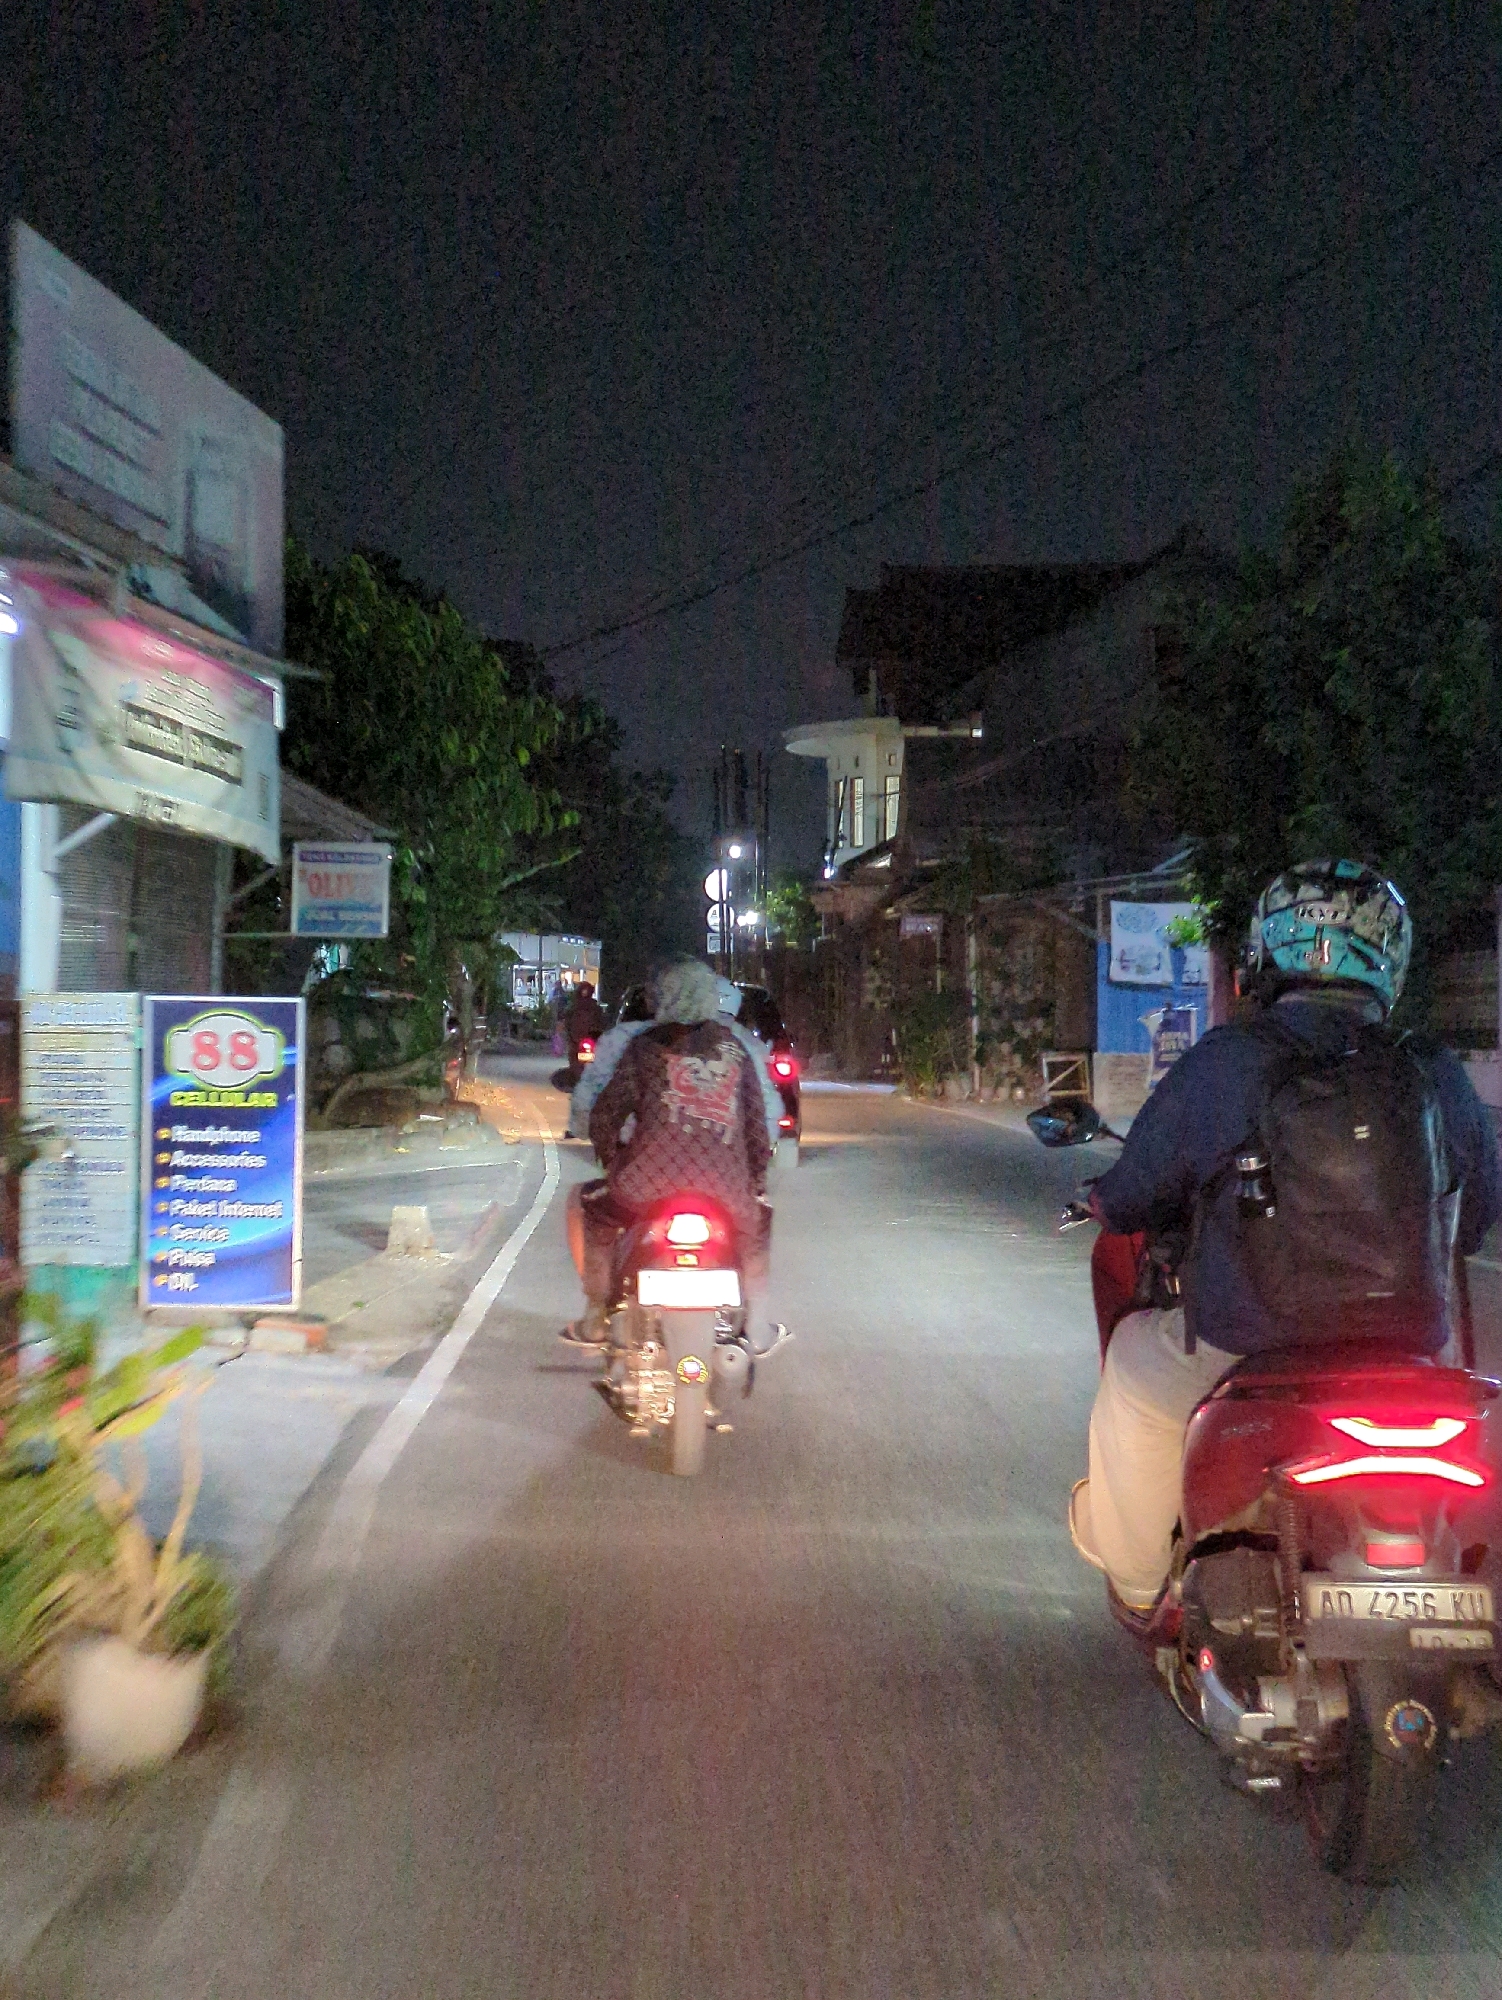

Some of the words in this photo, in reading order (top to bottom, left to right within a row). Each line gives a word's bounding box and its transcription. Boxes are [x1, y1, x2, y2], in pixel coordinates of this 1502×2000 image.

[192, 1030, 258, 1071] 88
[169, 1090, 279, 1108] CELLULAR
[170, 1125, 261, 1146] Handphone
[169, 1149, 268, 1169] Accessories
[170, 1174, 238, 1192] Perdana
[169, 1198, 217, 1218] Paket
[218, 1199, 284, 1219] Internet
[169, 1223, 230, 1242] Service
[168, 1248, 216, 1267] Pulsa
[1320, 1589, 1354, 1620] AD
[1368, 1590, 1437, 1620] 4256
[1450, 1590, 1486, 1621] KU
